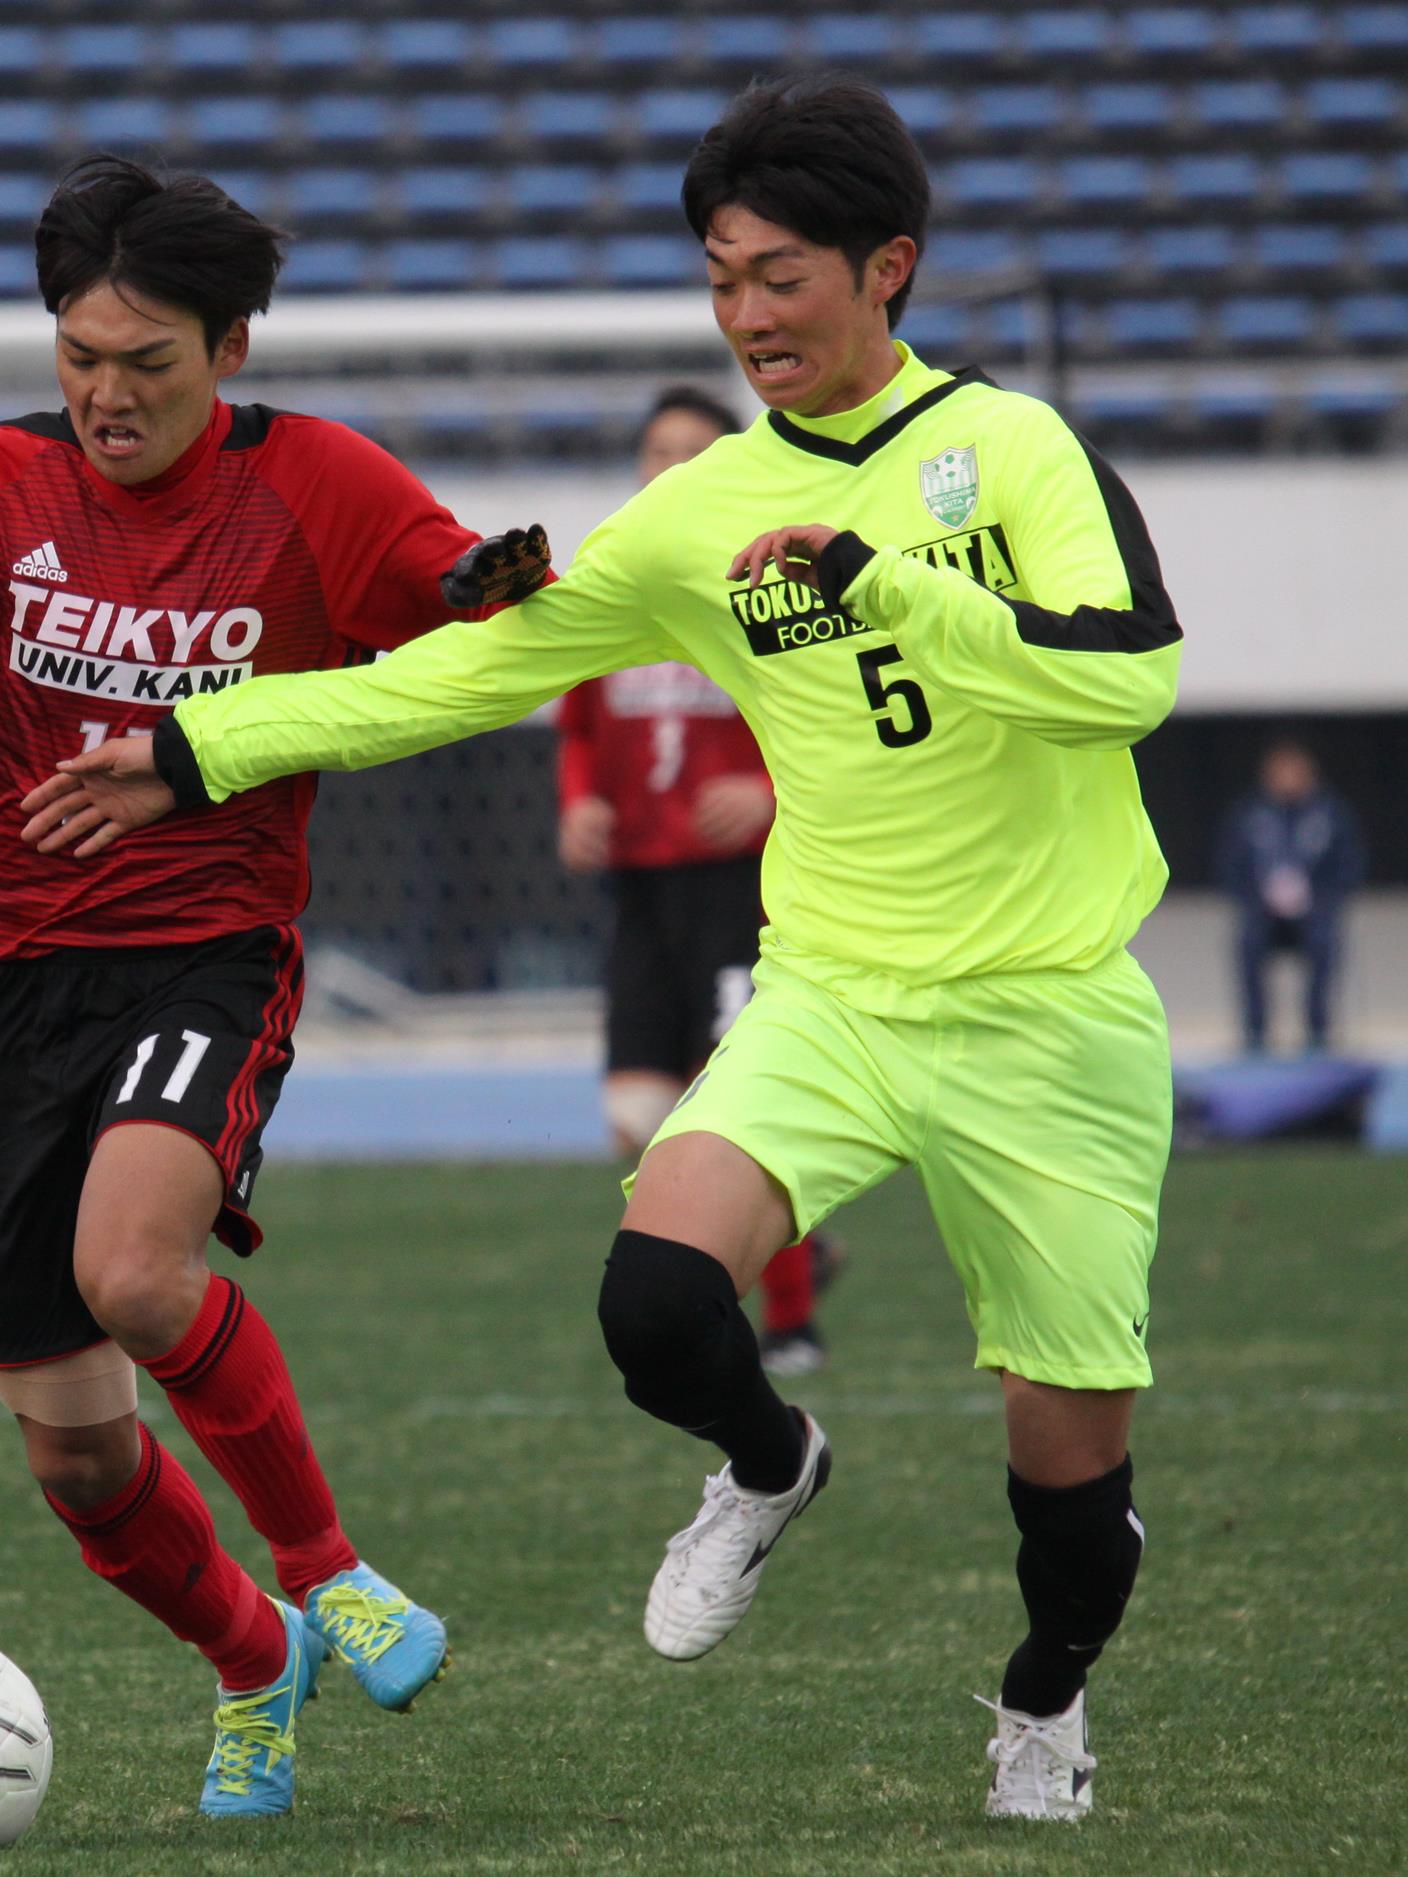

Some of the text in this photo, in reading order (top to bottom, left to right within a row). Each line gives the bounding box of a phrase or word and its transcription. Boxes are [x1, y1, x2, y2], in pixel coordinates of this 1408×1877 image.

[12, 561, 68, 583] adidas
[903, 528, 1016, 591] TA
[8, 580, 263, 664] TEIKYO
[777, 613, 873, 649] FOOT
[17, 642, 118, 694] UNIV.
[856, 643, 932, 748] 5
[115, 1028, 212, 1104] 11
